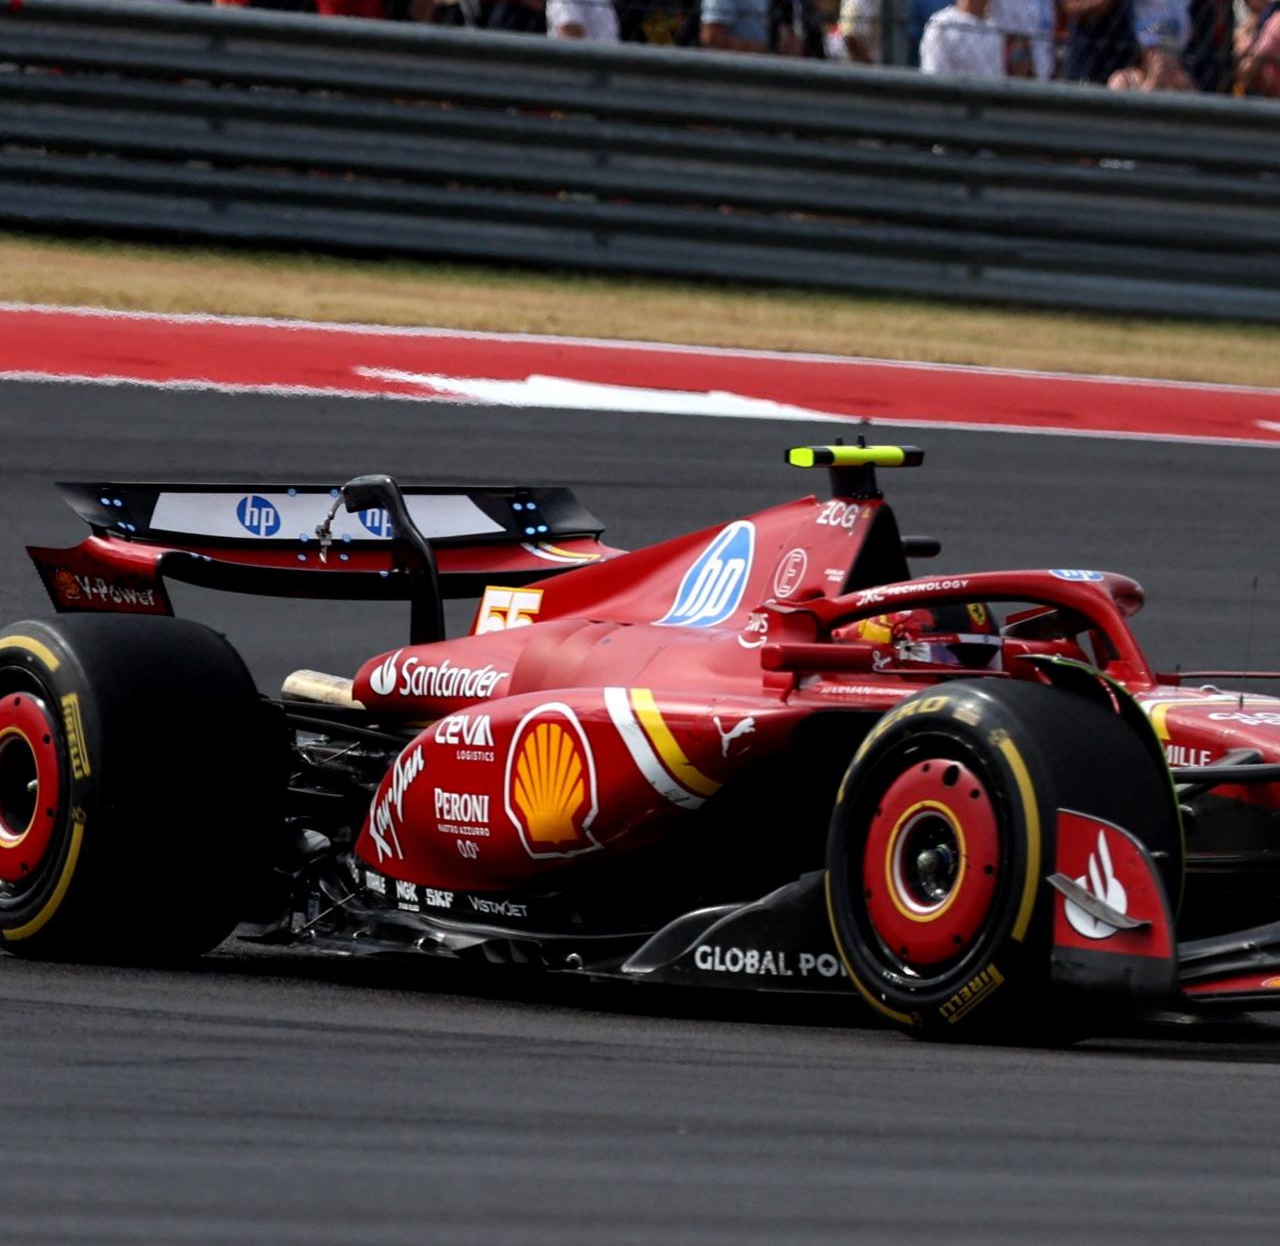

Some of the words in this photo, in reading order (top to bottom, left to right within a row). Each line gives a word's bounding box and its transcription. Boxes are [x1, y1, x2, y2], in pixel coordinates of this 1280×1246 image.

[236, 494, 282, 537] hp
[78, 570, 155, 607] V-Power
[652, 521, 755, 627] hp
[888, 579, 970, 596] TECHNOLOGY
[476, 585, 544, 635] 55
[399, 656, 510, 698] Santander
[60, 691, 91, 780] PIRELLI
[456, 749, 495, 762] LOGISTICS
[1166, 745, 1212, 767] ILLE
[434, 787, 490, 824] PERONI
[395, 880, 419, 902] NGK
[425, 888, 455, 909] SKF
[694, 945, 793, 976] GLOBAL
[938, 964, 1005, 1024] PIRELLI
